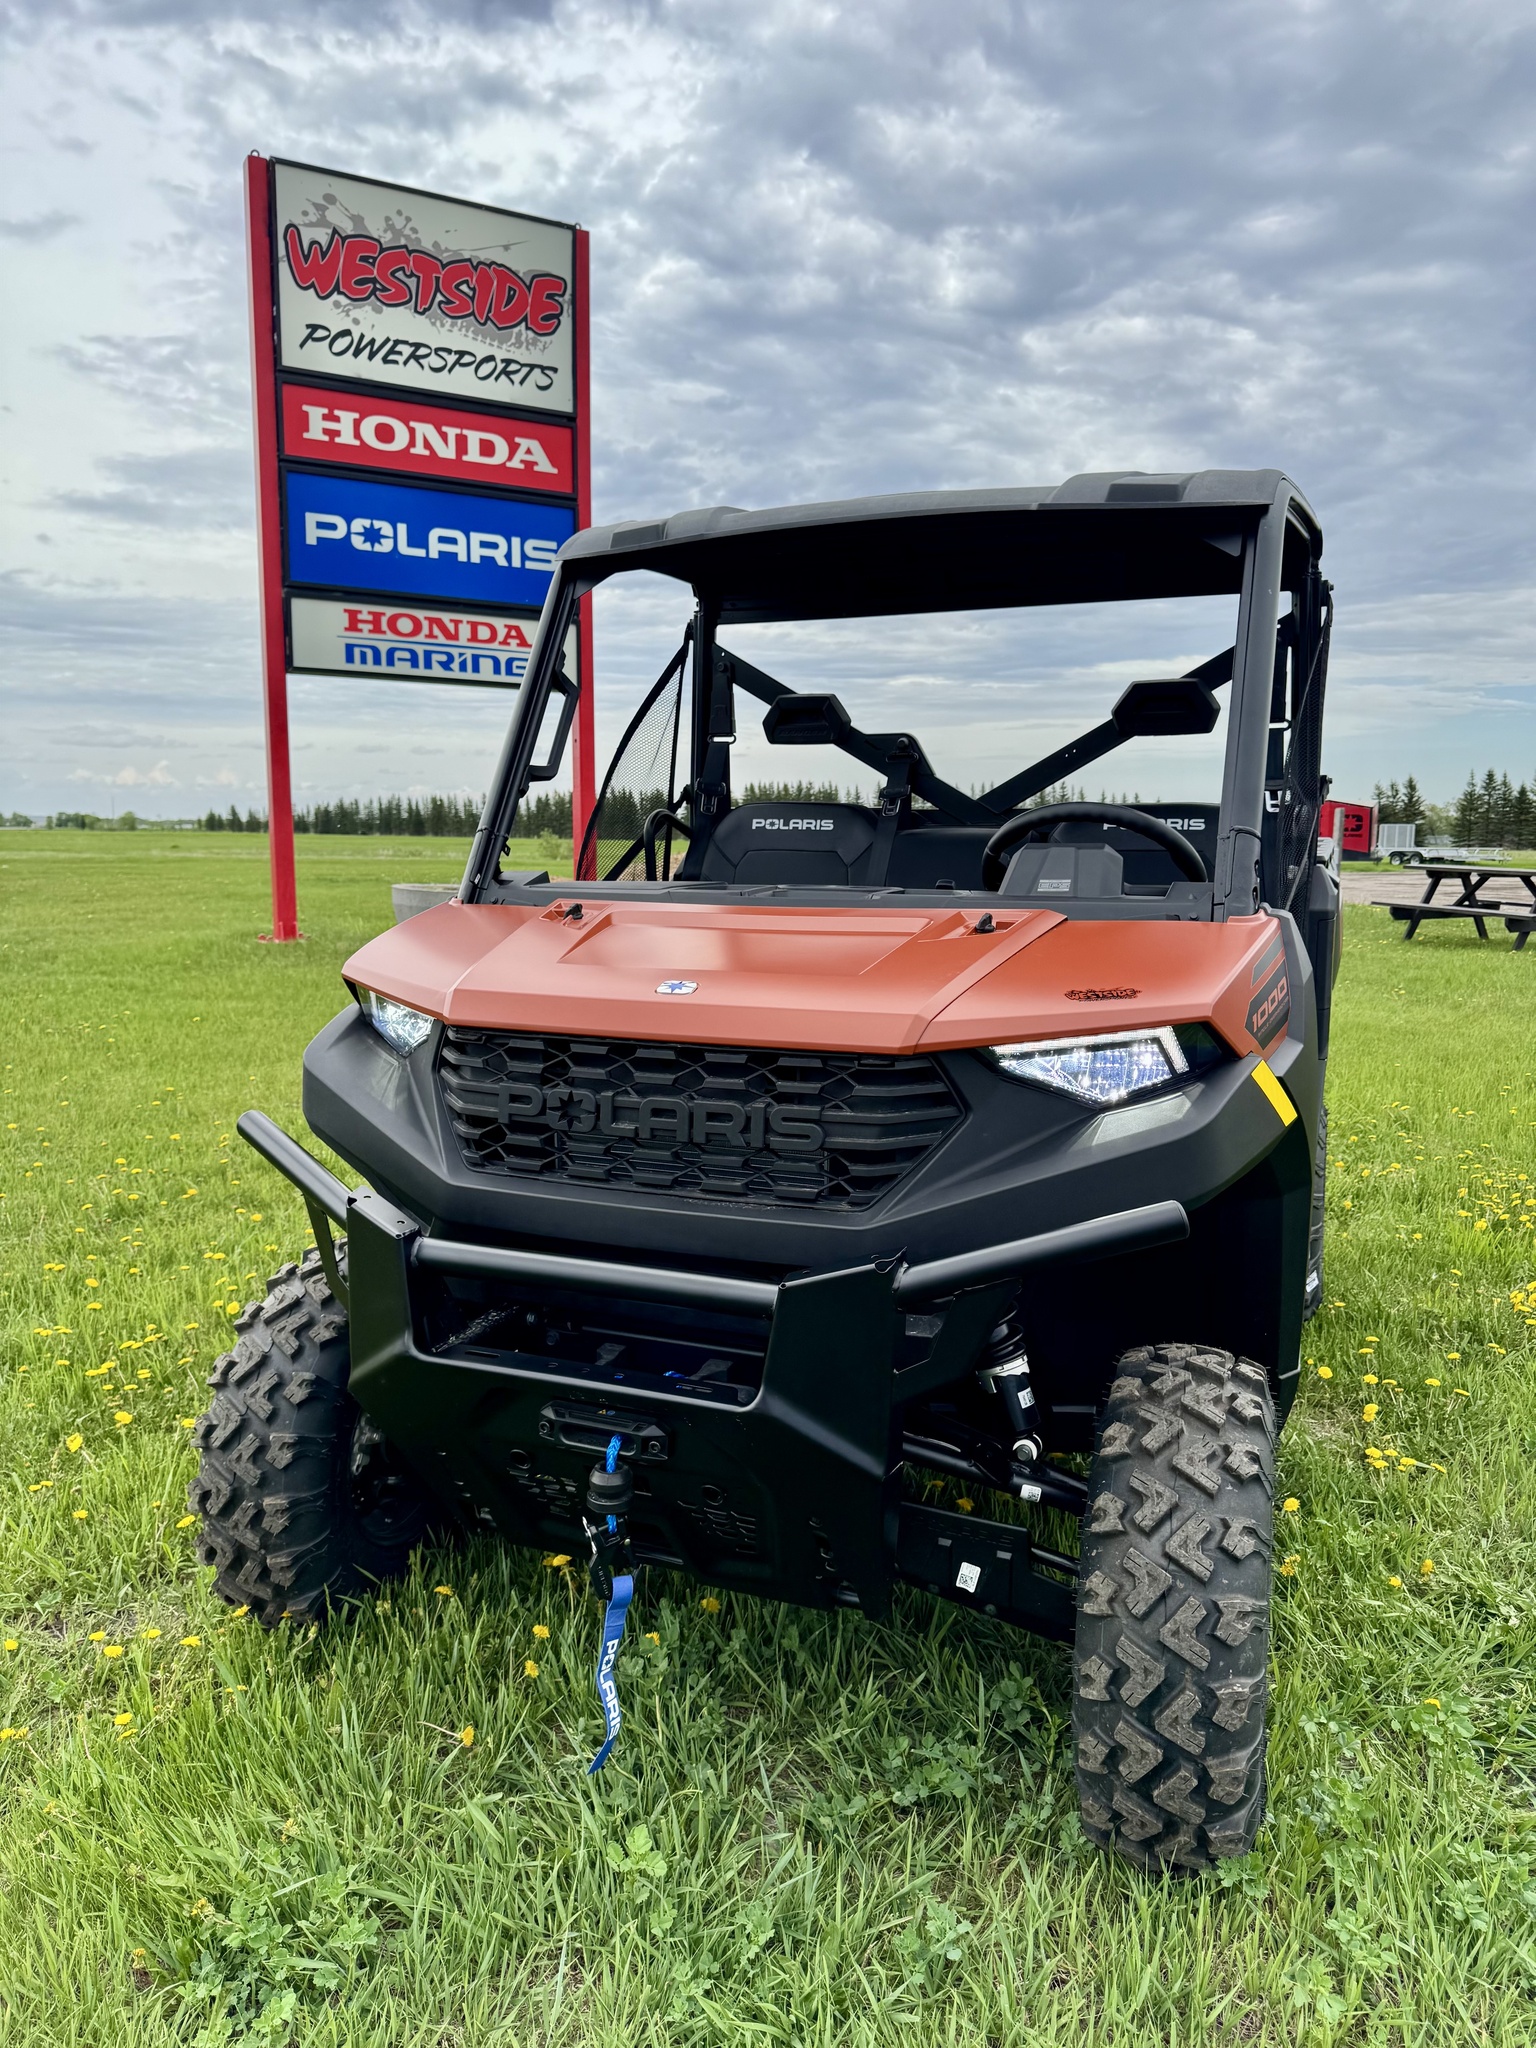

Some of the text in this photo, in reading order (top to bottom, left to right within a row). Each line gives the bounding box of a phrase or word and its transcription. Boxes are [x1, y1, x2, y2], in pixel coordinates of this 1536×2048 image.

[284, 224, 567, 336] WESTSIDE
[299, 323, 558, 391] POWERSPORTS
[302, 404, 558, 474] HONDA
[305, 512, 558, 572] POLARIS
[343, 608, 533, 648] HONDA
[752, 818, 834, 830] POLARIS
[1065, 988, 1137, 1001] WESTSIDE
[1252, 976, 1288, 1033] 1000
[499, 1084, 827, 1152] POLARIS
[600, 1638, 621, 1741] POLARIS
